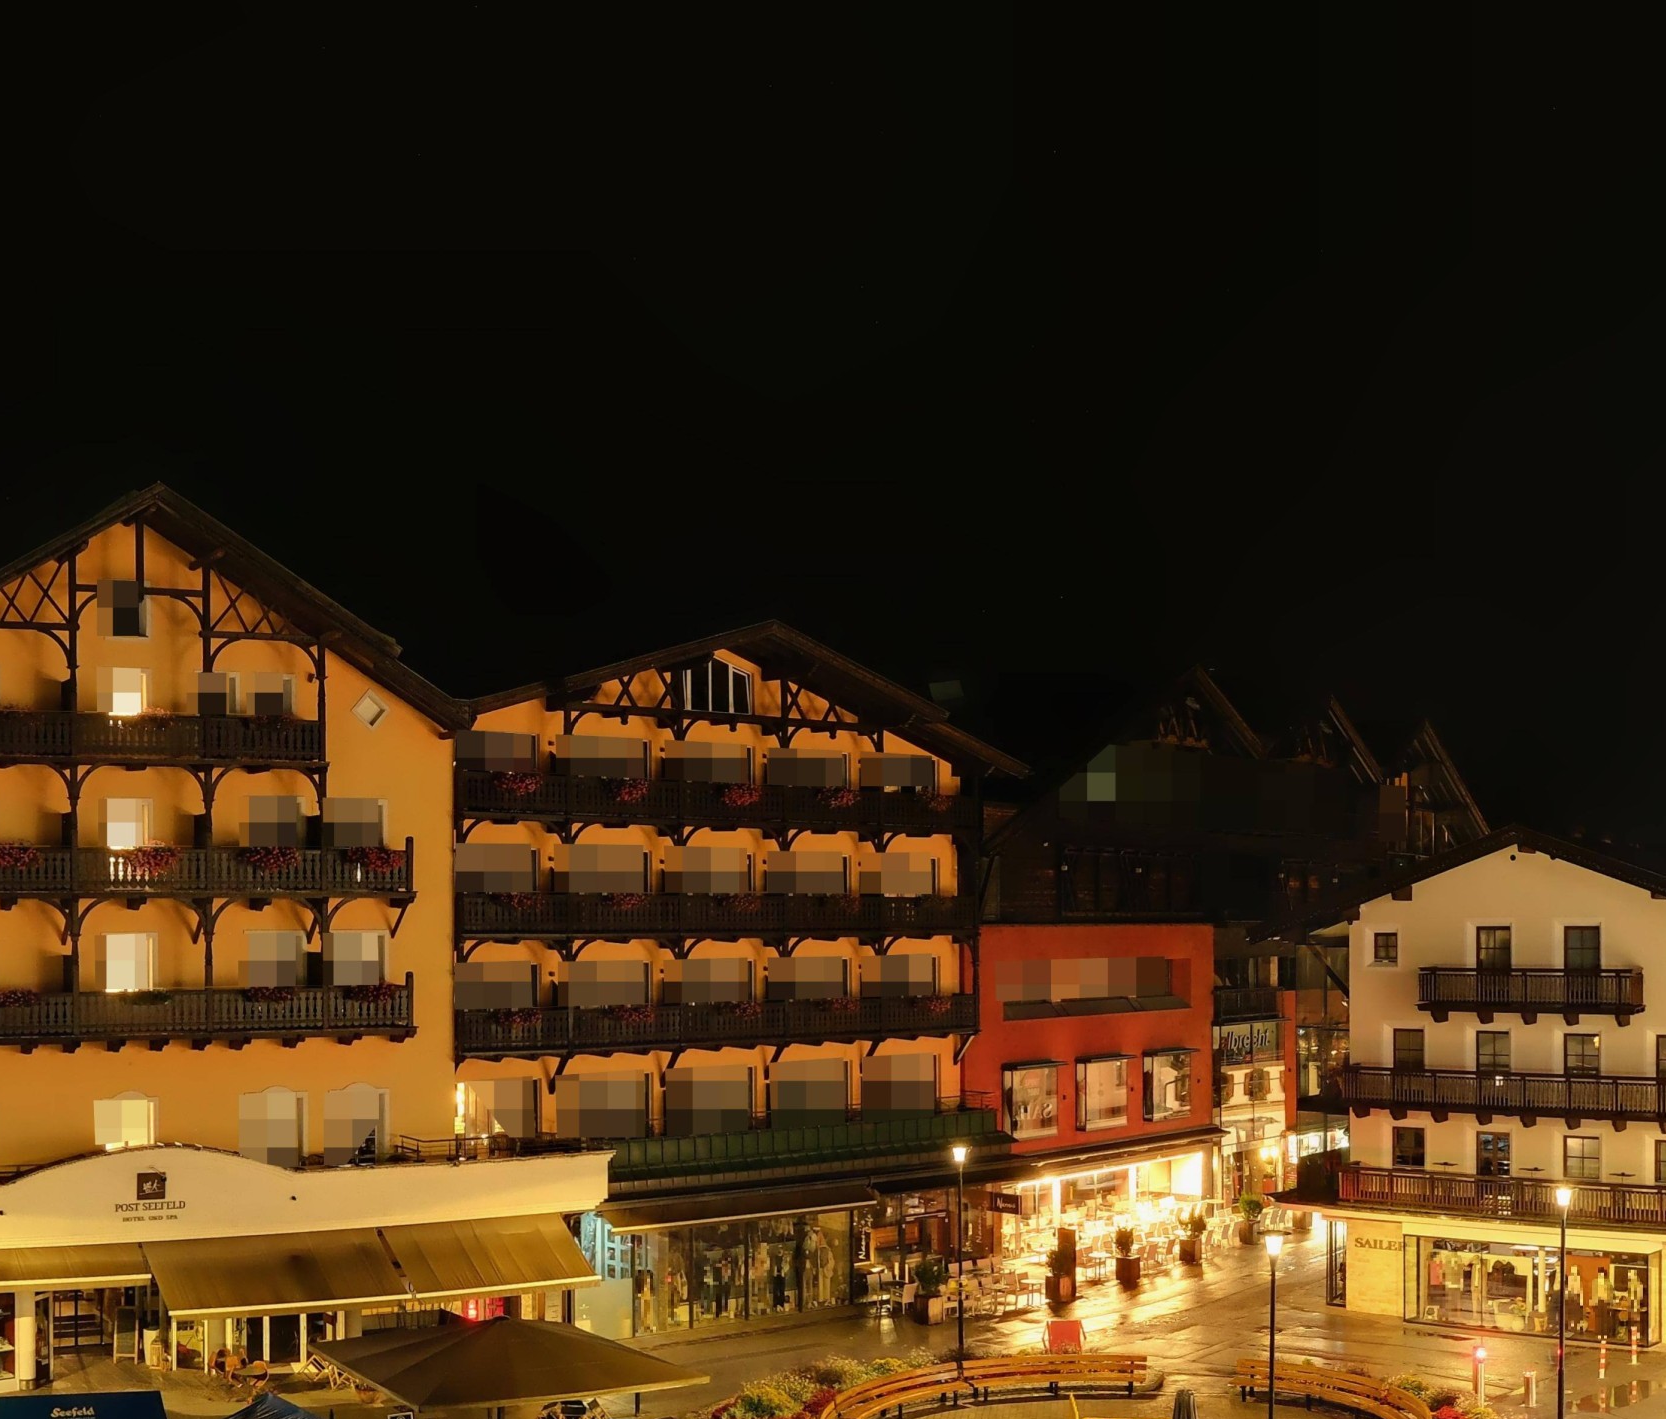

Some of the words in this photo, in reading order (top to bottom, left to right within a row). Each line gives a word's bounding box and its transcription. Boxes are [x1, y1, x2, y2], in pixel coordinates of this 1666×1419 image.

[115, 1203, 140, 1212] POST
[142, 1200, 186, 1211] SEEFELD
[50, 1406, 96, 1418] Seefeld
